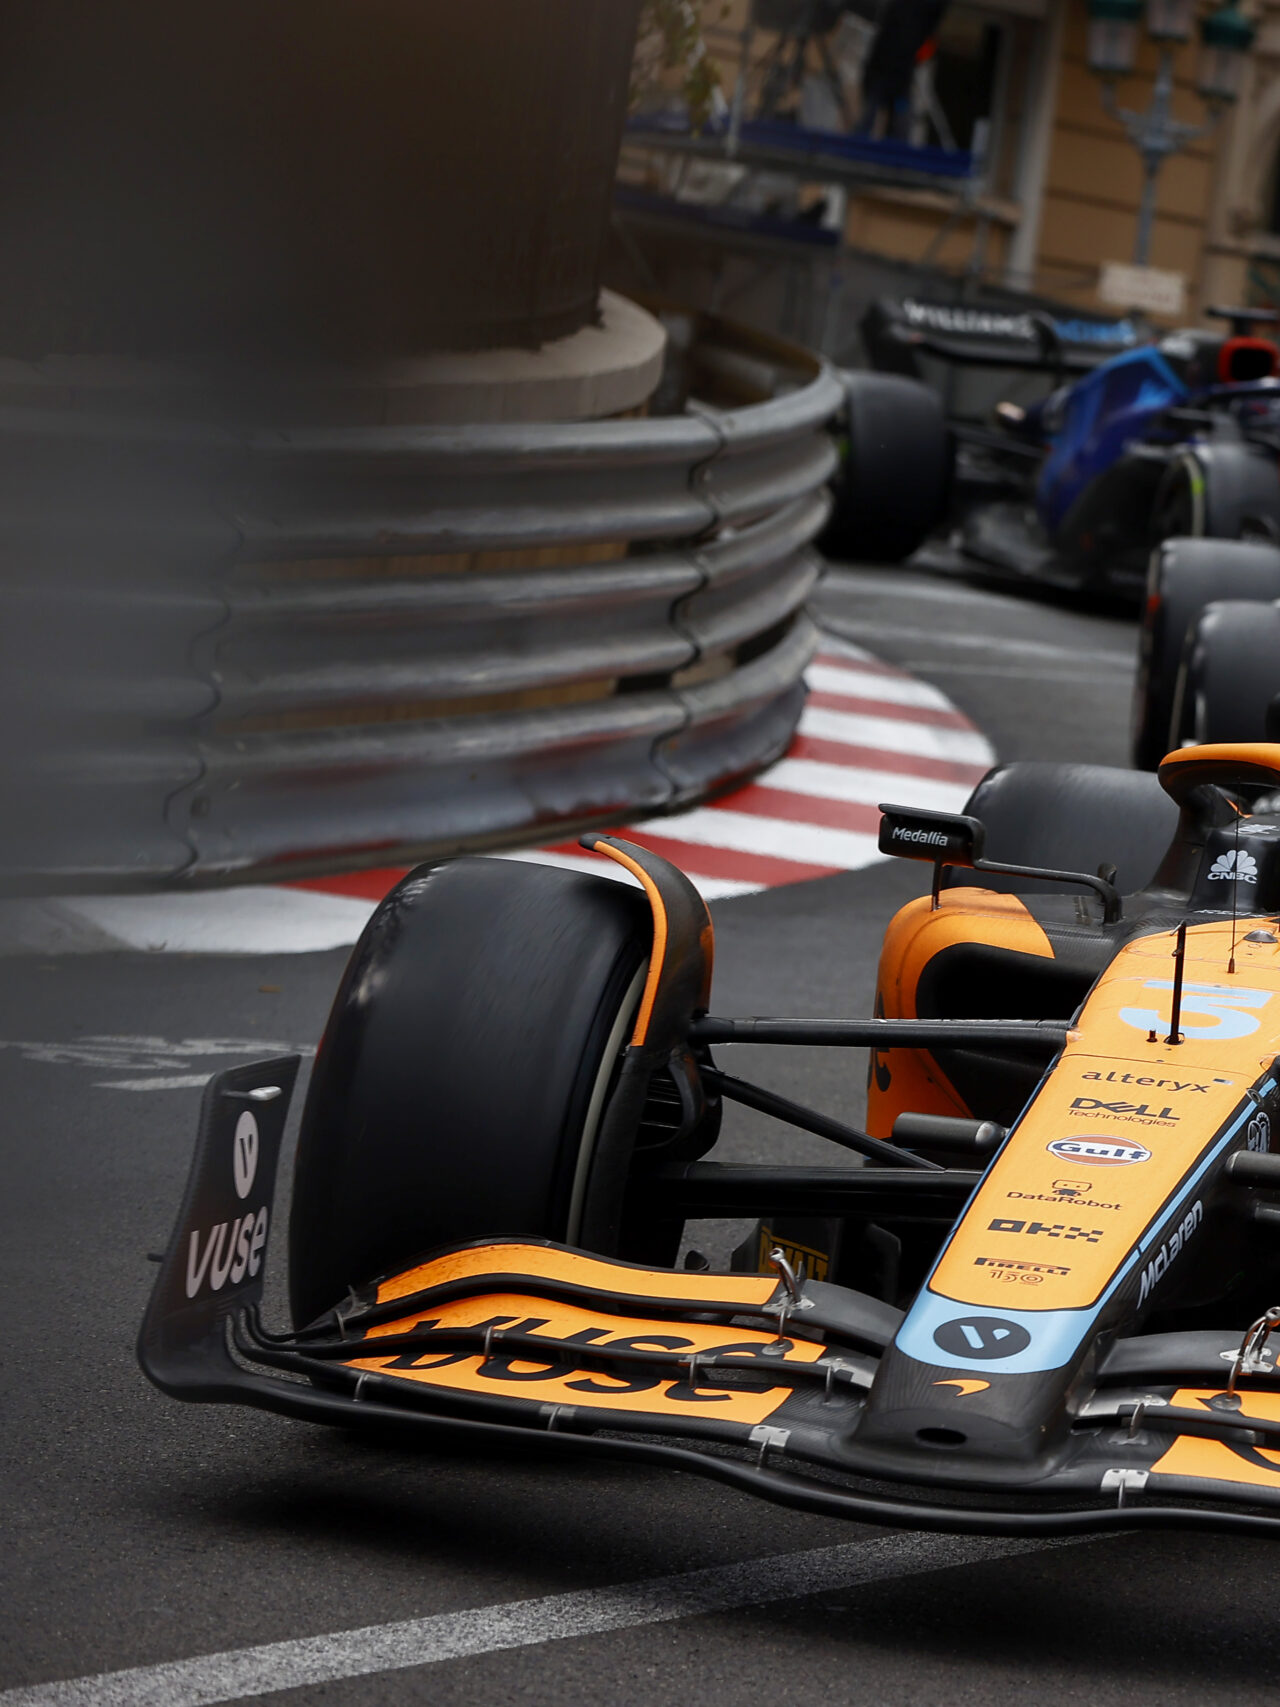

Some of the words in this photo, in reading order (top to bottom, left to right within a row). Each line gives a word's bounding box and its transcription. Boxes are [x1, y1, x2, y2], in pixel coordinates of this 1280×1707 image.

[891, 826, 949, 847] Medallia
[1207, 871, 1258, 884] CNBC
[1081, 1071, 1211, 1094] alteryx
[1067, 1108, 1177, 1128] Technologies
[1069, 1097, 1181, 1121] DELL
[1052, 1142, 1148, 1160] Gulf
[1006, 1191, 1124, 1211] DataRobot
[987, 1218, 1104, 1243] OKX
[758, 1231, 830, 1282] DWALT
[1136, 1199, 1205, 1311] McLaren
[973, 1256, 1072, 1276] PIRELLI
